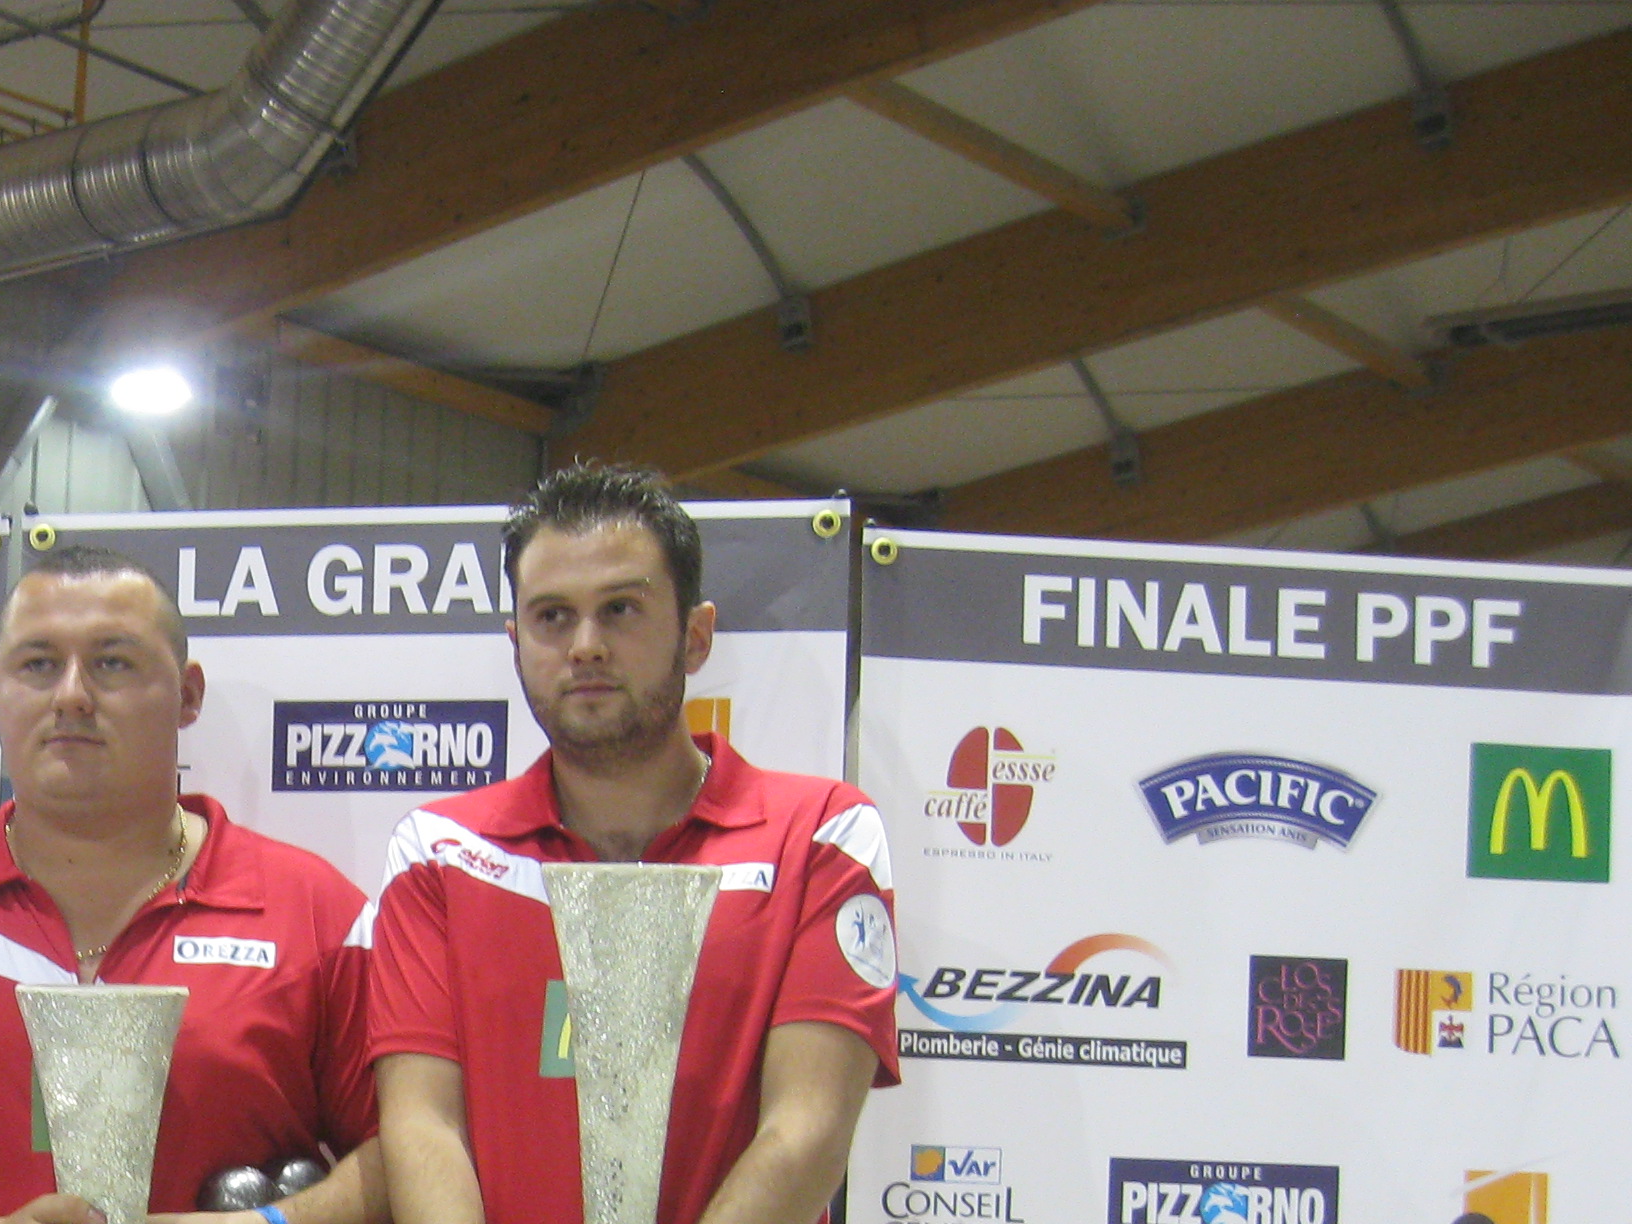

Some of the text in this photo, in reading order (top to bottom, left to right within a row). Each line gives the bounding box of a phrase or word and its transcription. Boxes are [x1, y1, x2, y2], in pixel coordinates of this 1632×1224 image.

[177, 545, 281, 618] LA
[1022, 573, 1522, 669] FINALE PPF
[354, 704, 427, 719] GROUPE
[285, 771, 493, 786] ENVIRONNEMENT
[992, 760, 1056, 783] essse
[924, 793, 988, 820] caffé
[1161, 769, 1355, 826] PACIFIC
[176, 939, 270, 964] OREZZA
[923, 967, 1162, 1009] BEZZINA
[1488, 972, 1617, 1019] Région
[900, 1032, 999, 1057] Plomberie
[1018, 1036, 1074, 1061] Génie
[1079, 1039, 1183, 1068] climatique
[1487, 1014, 1621, 1059] PACA
[1190, 1164, 1263, 1181] GROUPE
[881, 1181, 1025, 1224] CONSEIL
